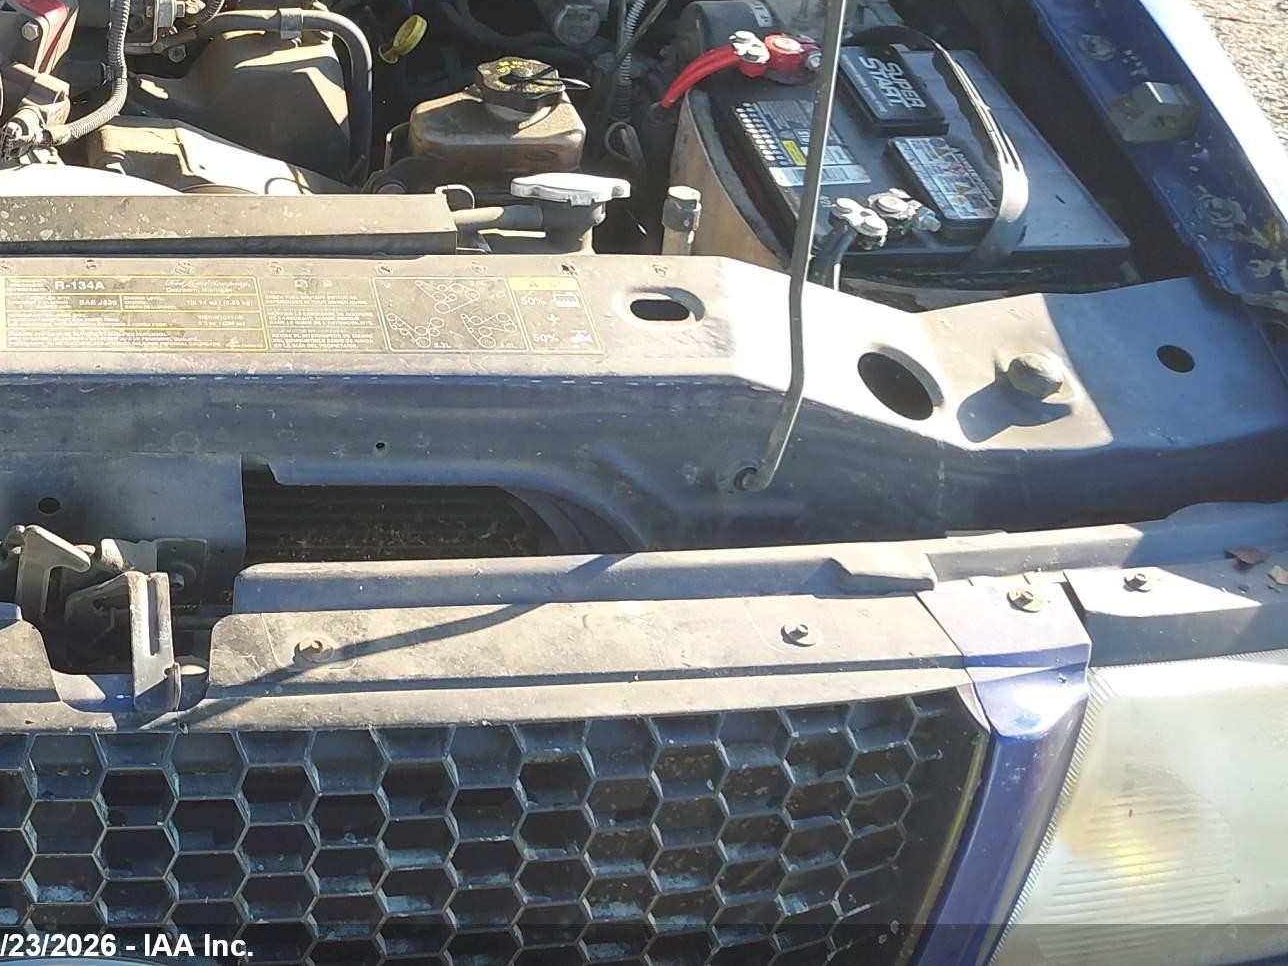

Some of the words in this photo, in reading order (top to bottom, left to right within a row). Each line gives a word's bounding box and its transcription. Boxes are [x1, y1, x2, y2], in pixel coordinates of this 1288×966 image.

[858, 56, 910, 108] START
[885, 62, 927, 108] SUPER
[54, 280, 105, 291] R-134A
